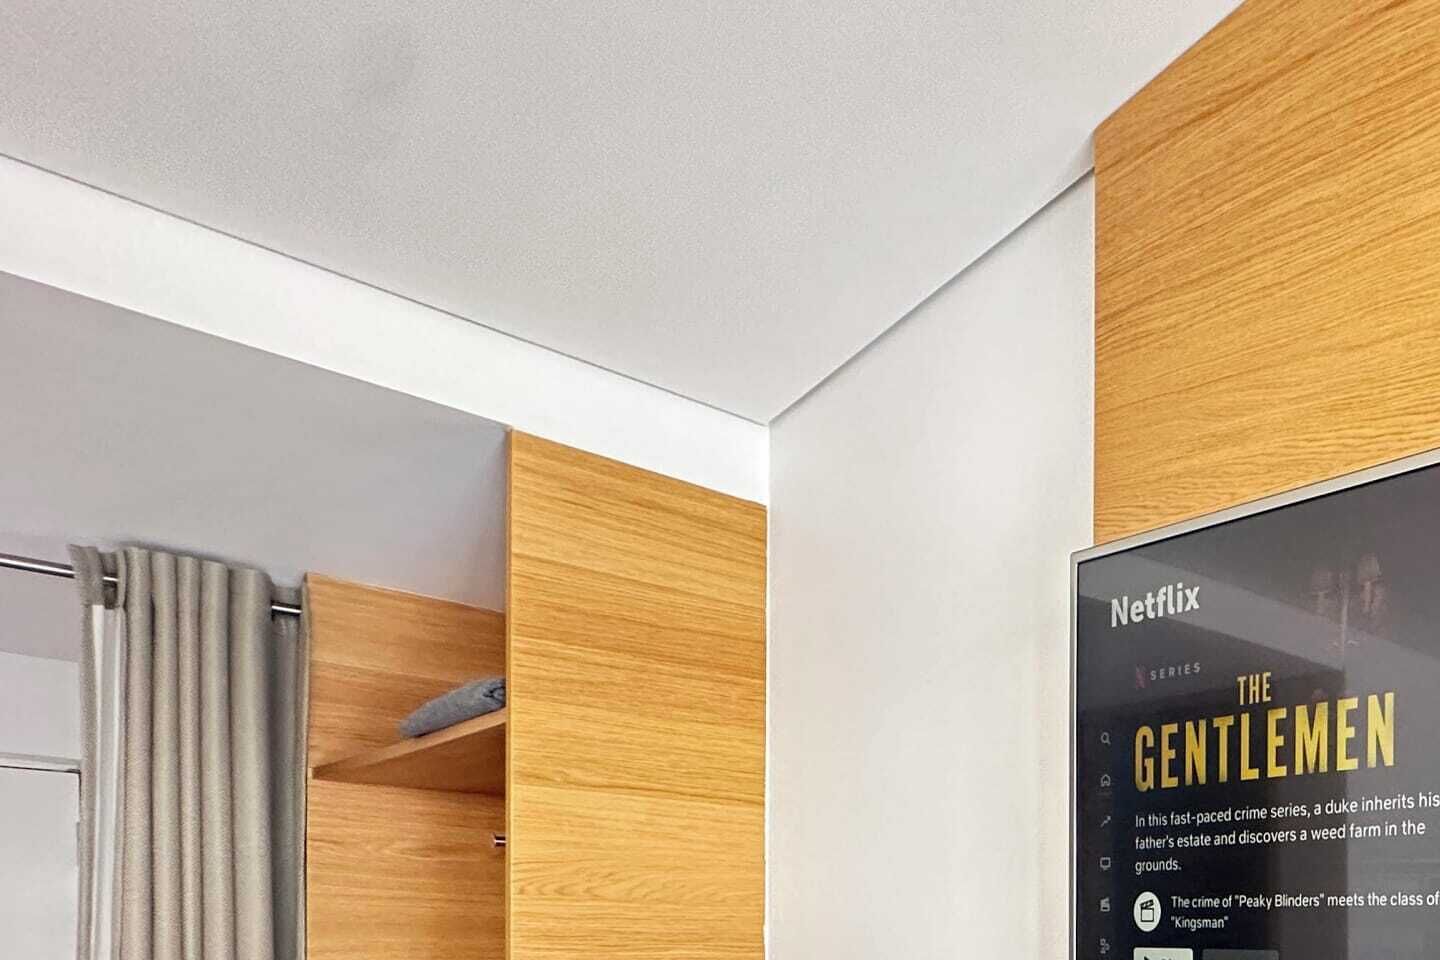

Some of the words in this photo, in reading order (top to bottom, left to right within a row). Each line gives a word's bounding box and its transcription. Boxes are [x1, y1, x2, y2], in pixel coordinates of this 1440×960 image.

[1111, 582, 1200, 628] Netflix
[1150, 662, 1200, 681] SERIES
[1237, 671, 1272, 705] THE
[1135, 692, 1395, 792] GENTLEMEN
[1135, 815, 1145, 828] In
[1148, 813, 1168, 827] this
[1170, 807, 1232, 826] fast-paced
[1234, 806, 1267, 821] crime
[1270, 802, 1311, 819] series,
[1313, 803, 1322, 816] a
[1325, 798, 1358, 815] duke
[1361, 794, 1415, 812] inherits
[1418, 791, 1440, 808] his
[1135, 835, 1175, 850] father's
[1177, 833, 1211, 848] estate
[1214, 831, 1236, 846] and
[1238, 829, 1297, 845] discovers
[1299, 829, 1308, 841] a
[1311, 824, 1346, 841] weed
[1349, 822, 1381, 838] farm
[1384, 820, 1398, 836] in
[1401, 819, 1426, 835] the
[1135, 857, 1182, 875] grounds.
[1171, 895, 1190, 908] The
[1191, 895, 1220, 908] crime
[1222, 894, 1232, 908] of
[1234, 893, 1273, 910] "Peaky
[1274, 892, 1324, 908] Blinders"
[1327, 893, 1365, 907] meets
[1367, 891, 1388, 906] the
[1390, 891, 1424, 906] class
[1426, 890, 1440, 906] of
[1171, 916, 1229, 931] "Kingsman"
